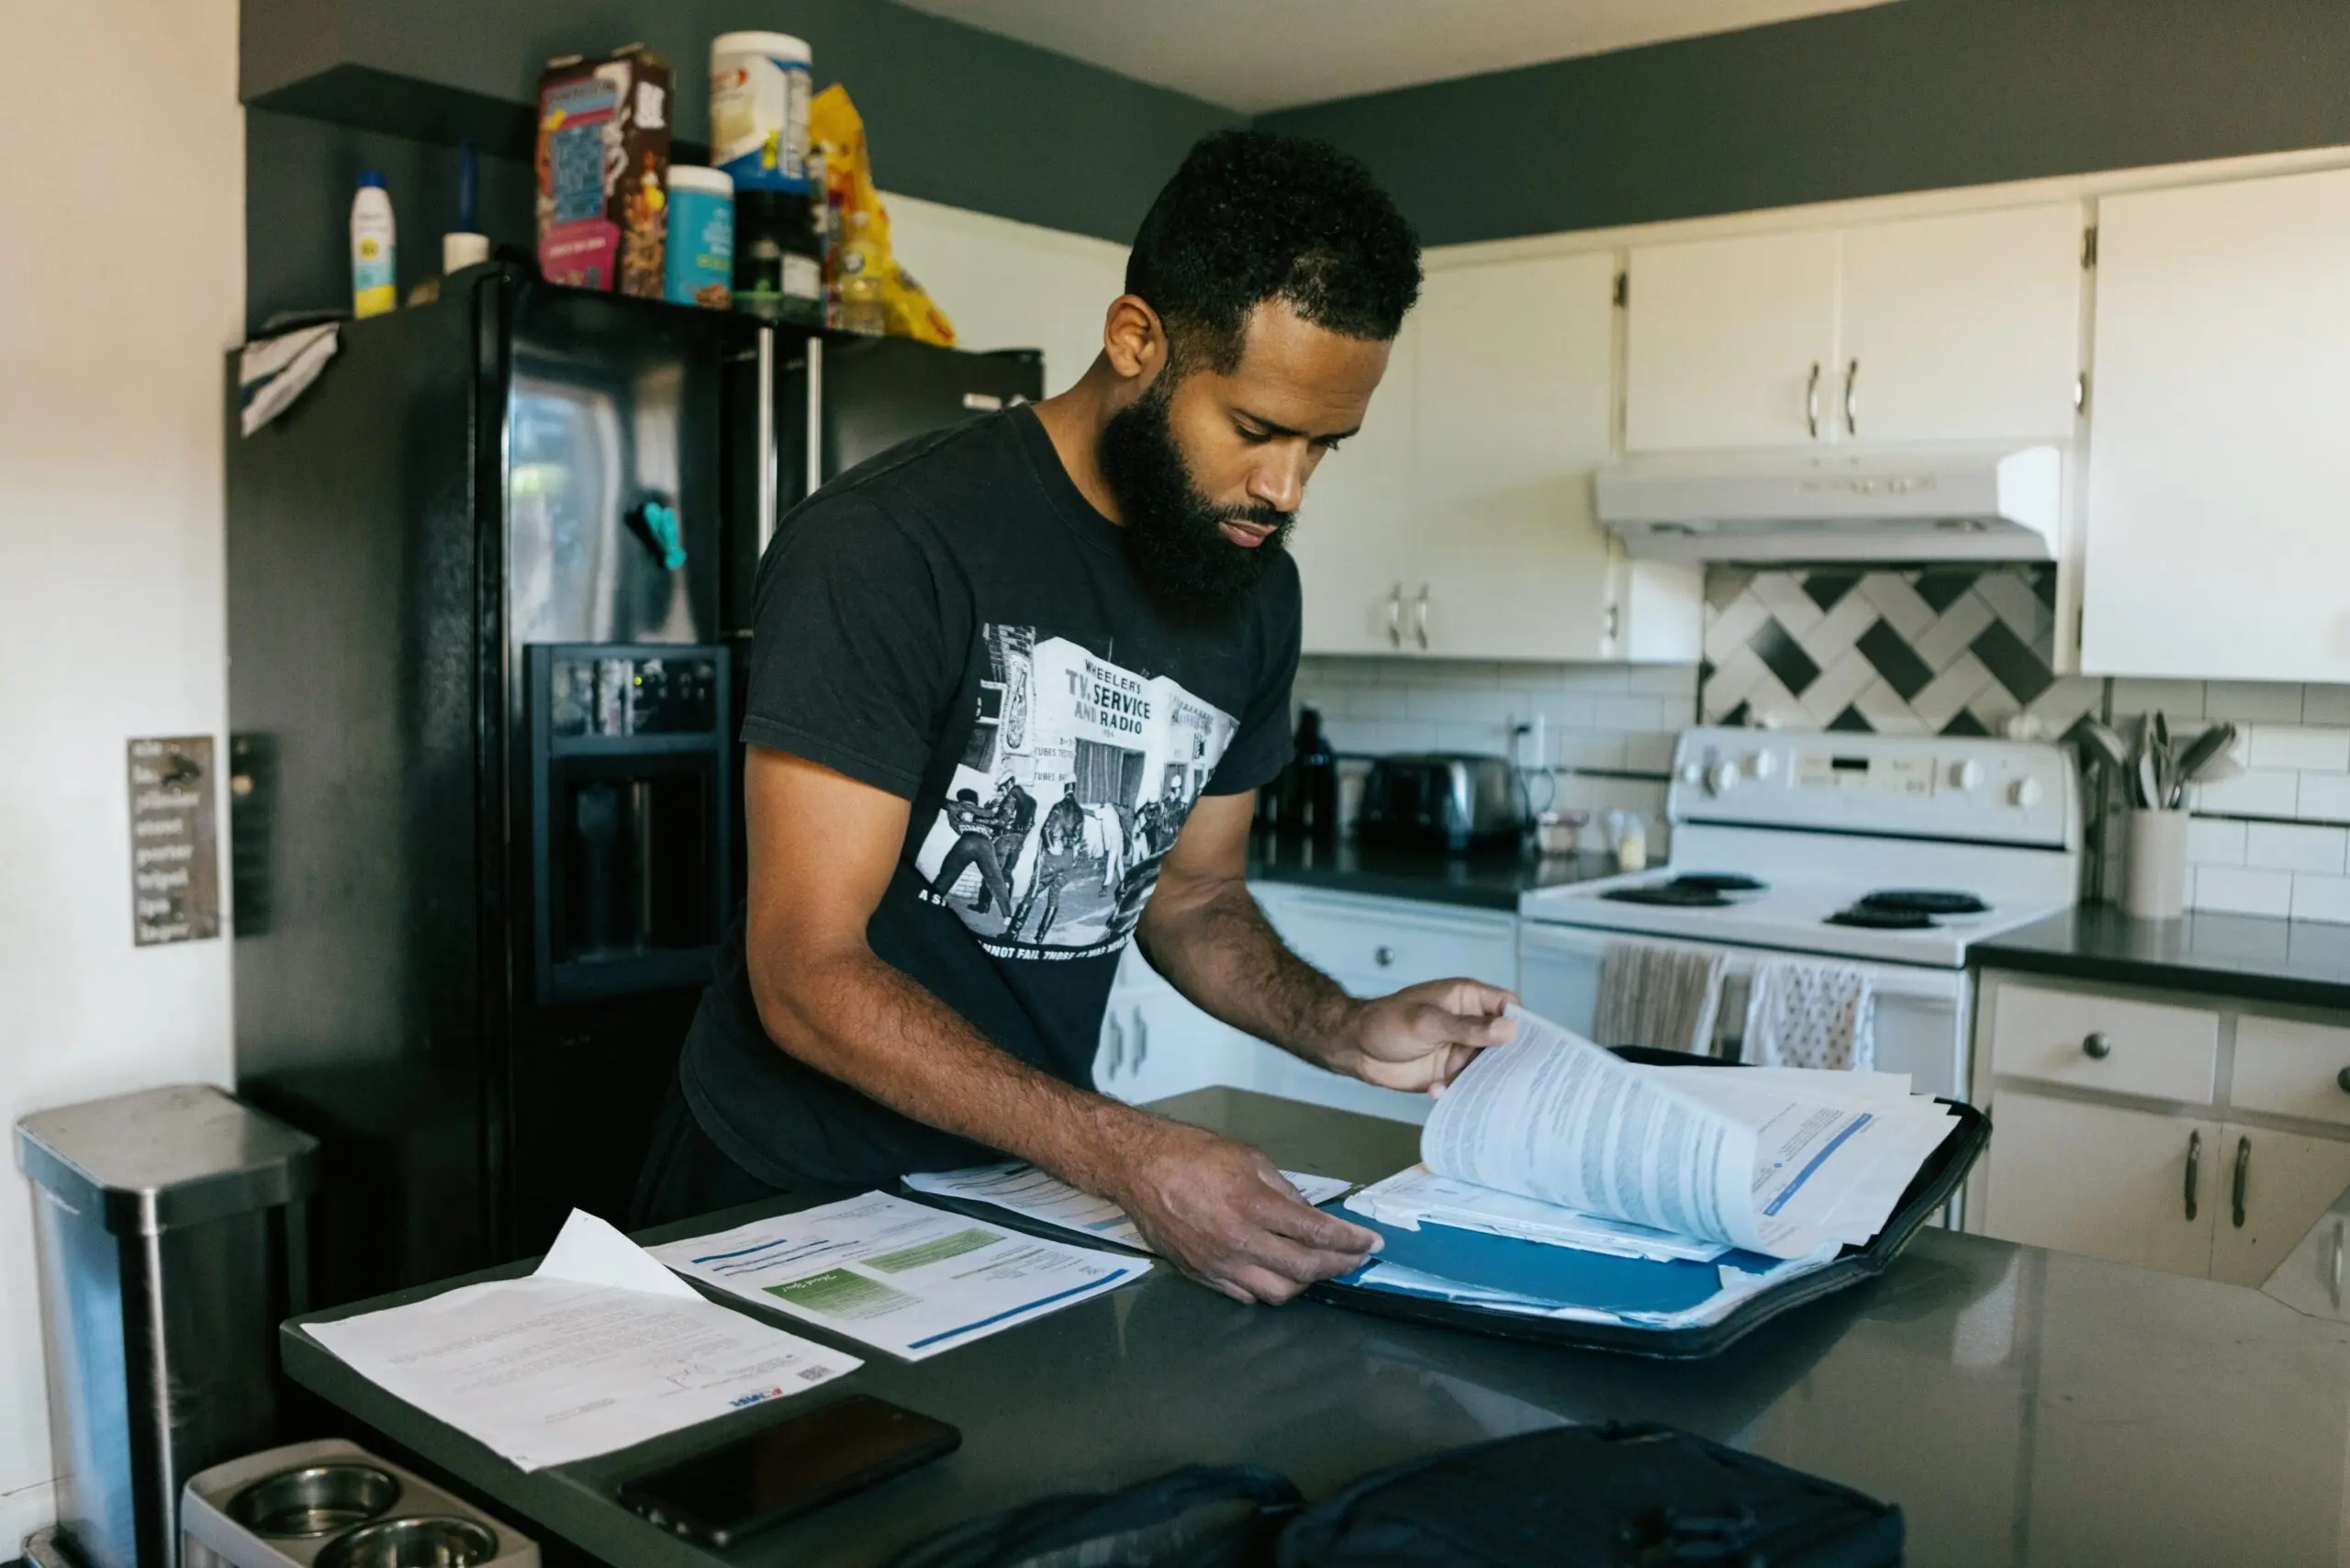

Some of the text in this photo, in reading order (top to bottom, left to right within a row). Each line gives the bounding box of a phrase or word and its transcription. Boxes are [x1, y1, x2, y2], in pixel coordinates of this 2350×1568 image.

[1085, 658, 1142, 695] WHEELER'S
[1074, 700, 1097, 723] AND
[1100, 709, 1143, 734] RADIO
[1092, 684, 1151, 720] SERVICE
[1016, 947, 1040, 960] FAIL
